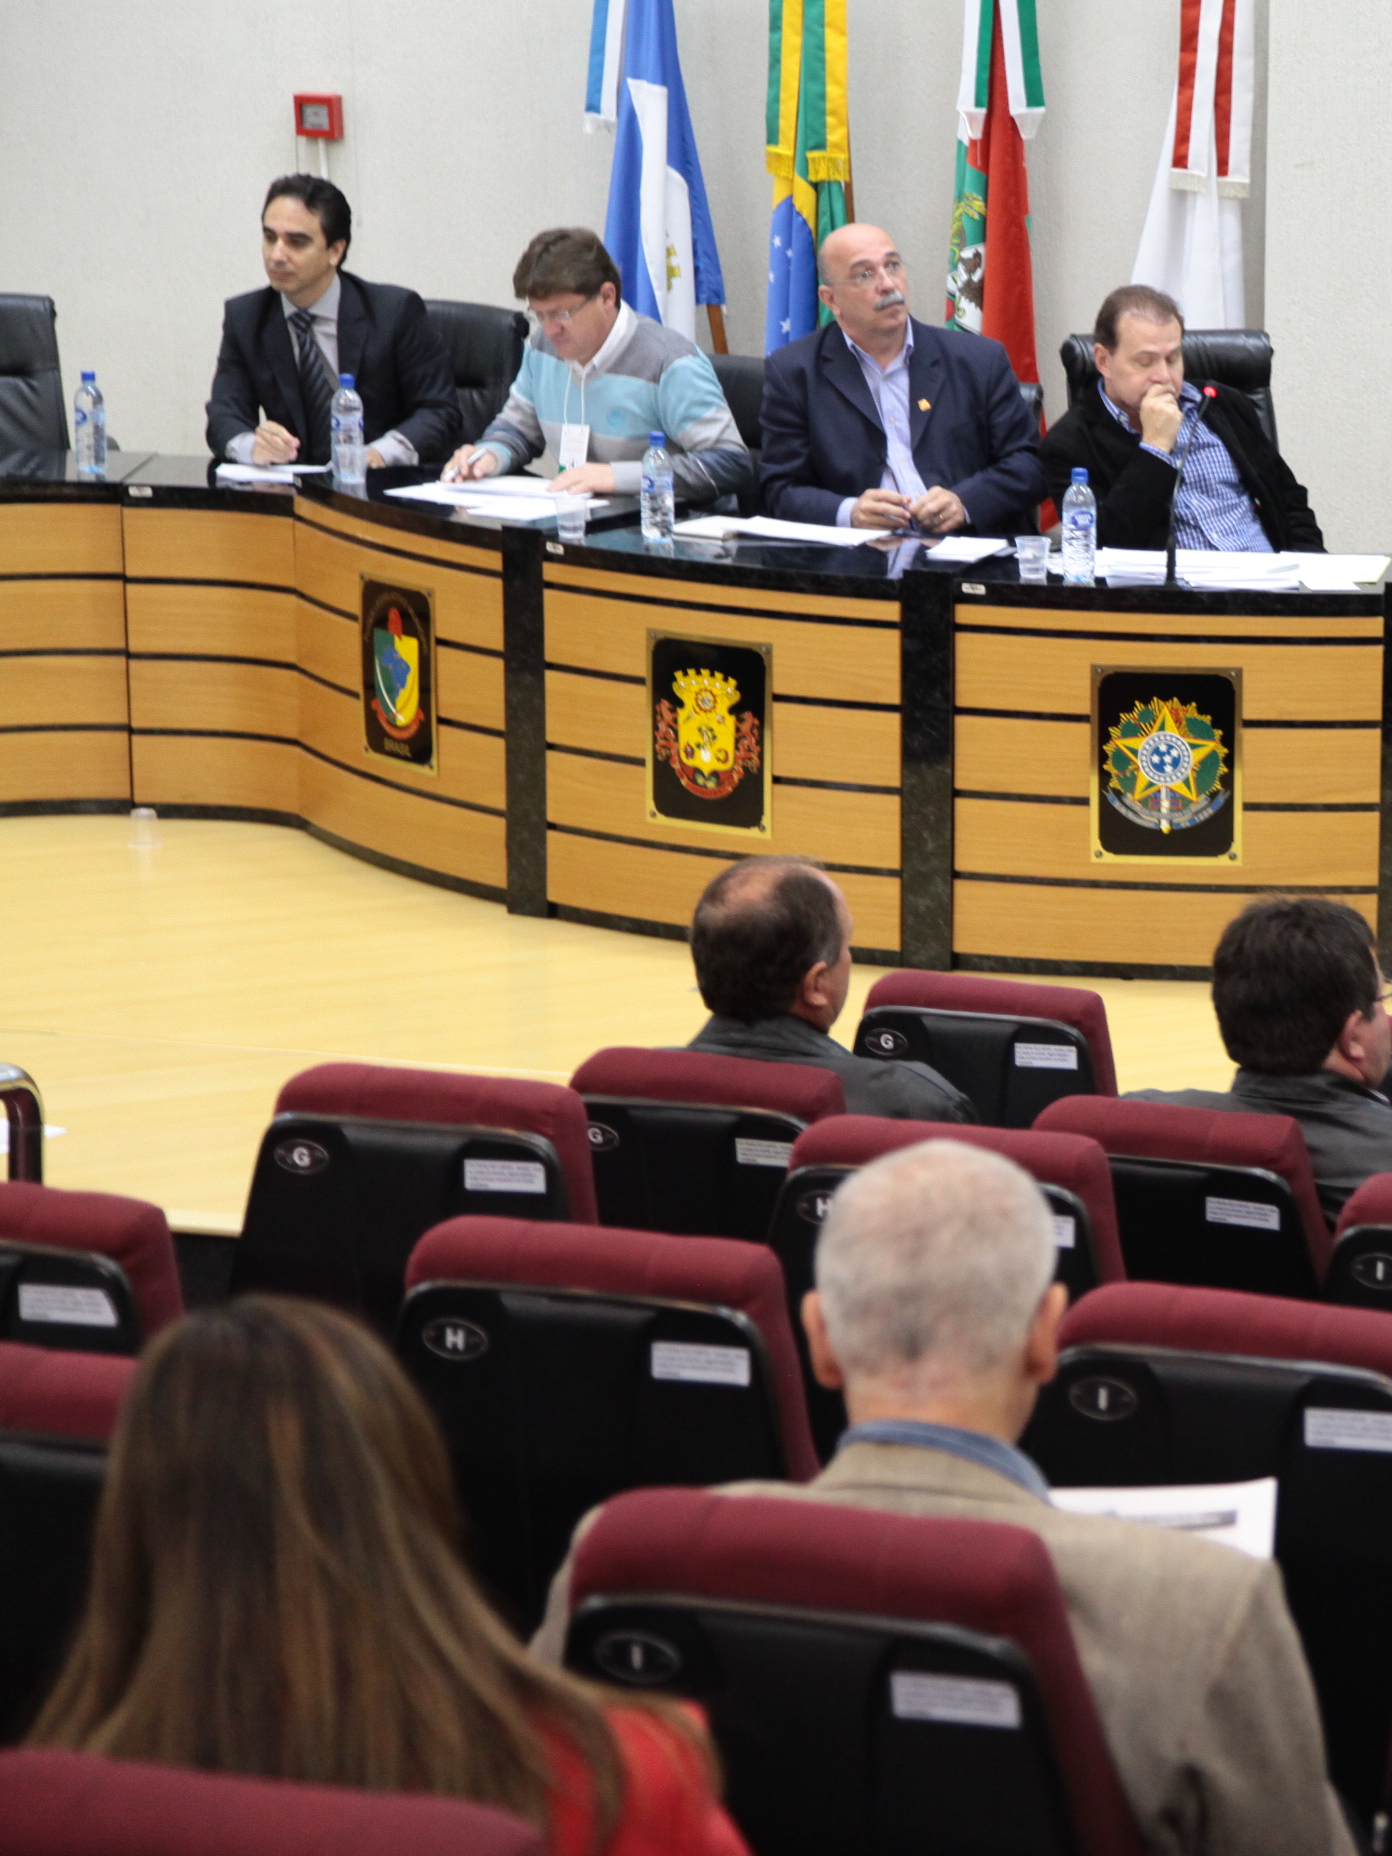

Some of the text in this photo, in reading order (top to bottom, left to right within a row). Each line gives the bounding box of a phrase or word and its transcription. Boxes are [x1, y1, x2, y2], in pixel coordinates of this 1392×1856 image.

[880, 1034, 894, 1049] G
[587, 1127, 603, 1144] G
[293, 1147, 310, 1167] G
[445, 1327, 464, 1350] H
